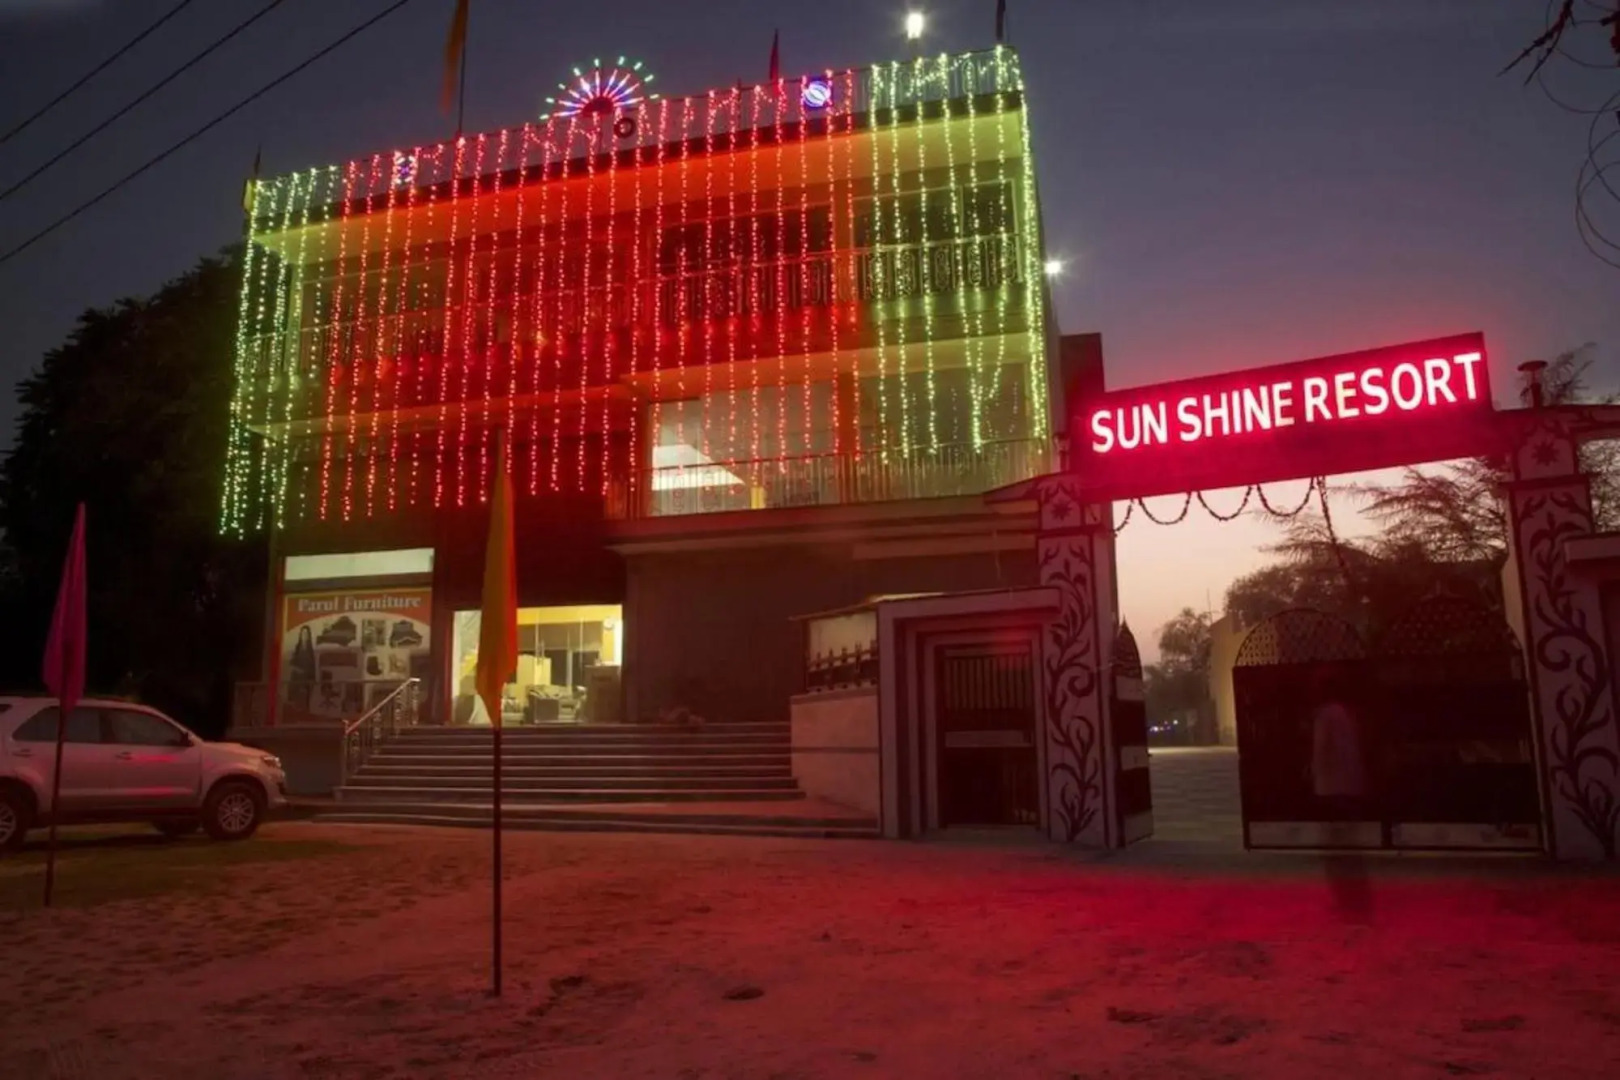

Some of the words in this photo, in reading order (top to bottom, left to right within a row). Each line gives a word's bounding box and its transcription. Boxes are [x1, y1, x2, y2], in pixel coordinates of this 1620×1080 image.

[1091, 401, 1168, 453] SUN
[1177, 381, 1295, 442] SHINE
[1304, 352, 1482, 422] RESORT
[344, 593, 421, 611] Furniture
